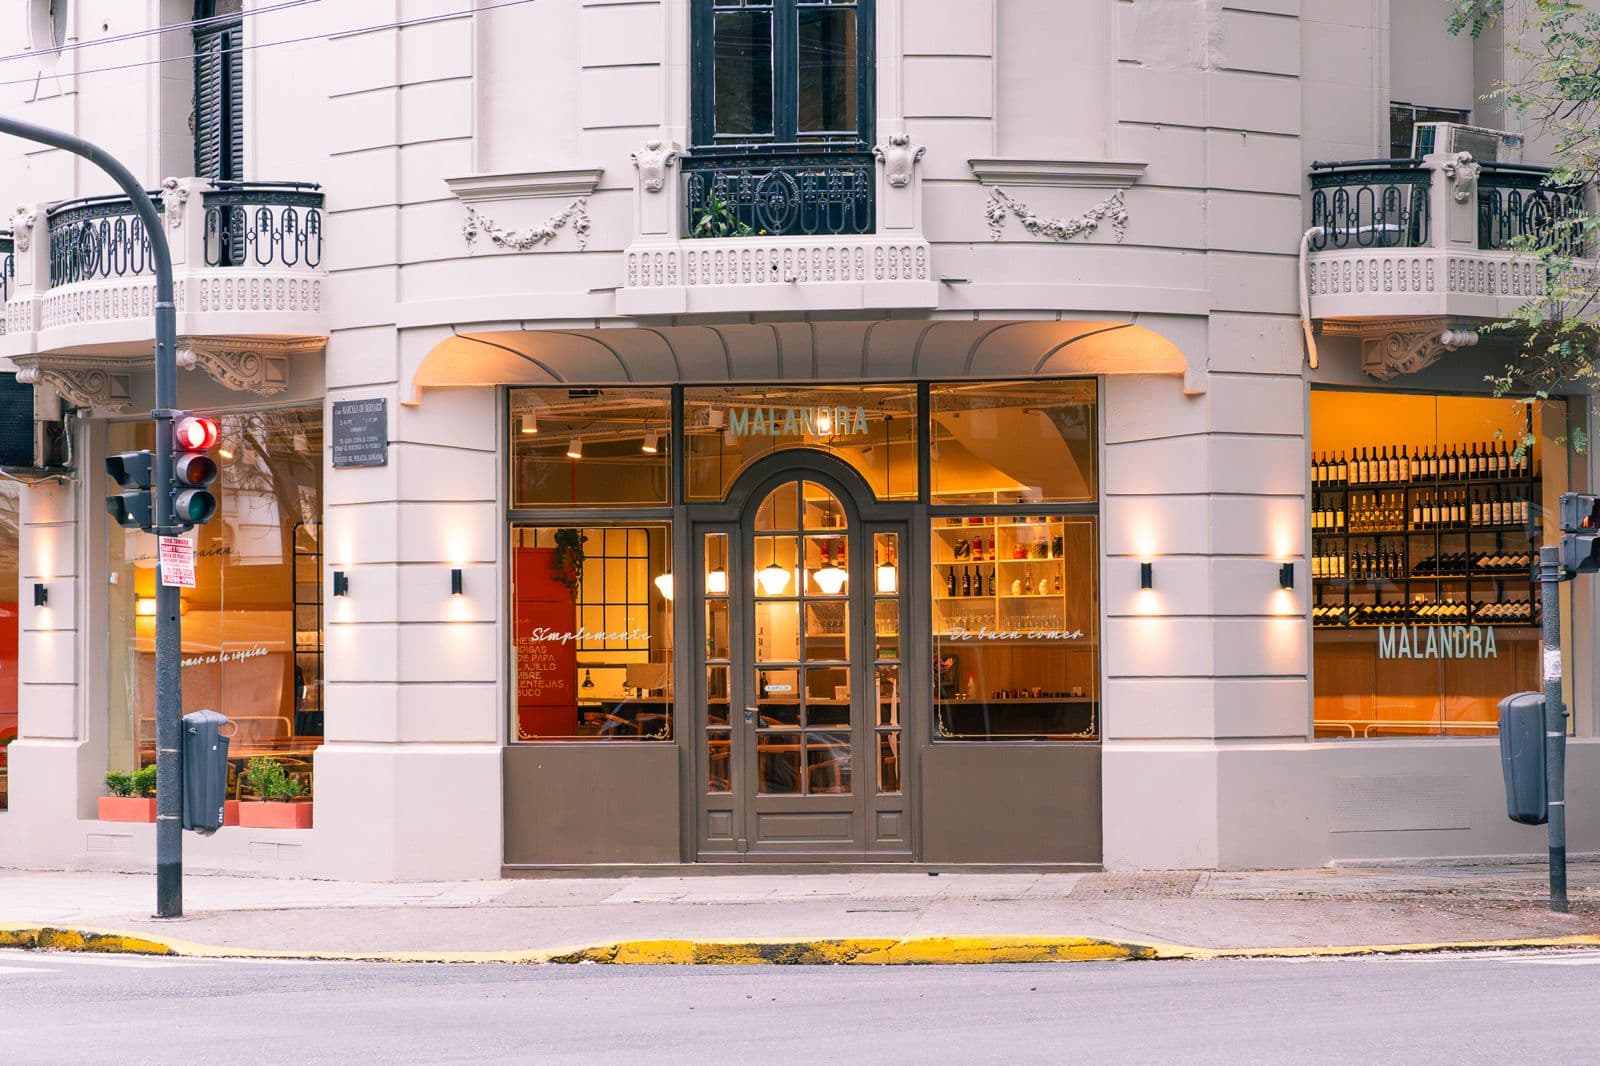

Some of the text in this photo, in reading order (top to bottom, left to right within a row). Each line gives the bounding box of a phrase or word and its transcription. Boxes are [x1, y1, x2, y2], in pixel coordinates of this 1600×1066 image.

[729, 406, 869, 436] MALANDRA
[530, 626, 652, 646] Simplemente
[947, 626, 1084, 640] De buen comer
[1378, 625, 1498, 659] MALANDRA
[519, 645, 547, 654] DIGAS
[531, 654, 555, 662] PAPA
[518, 680, 565, 688] ENTEJAS
